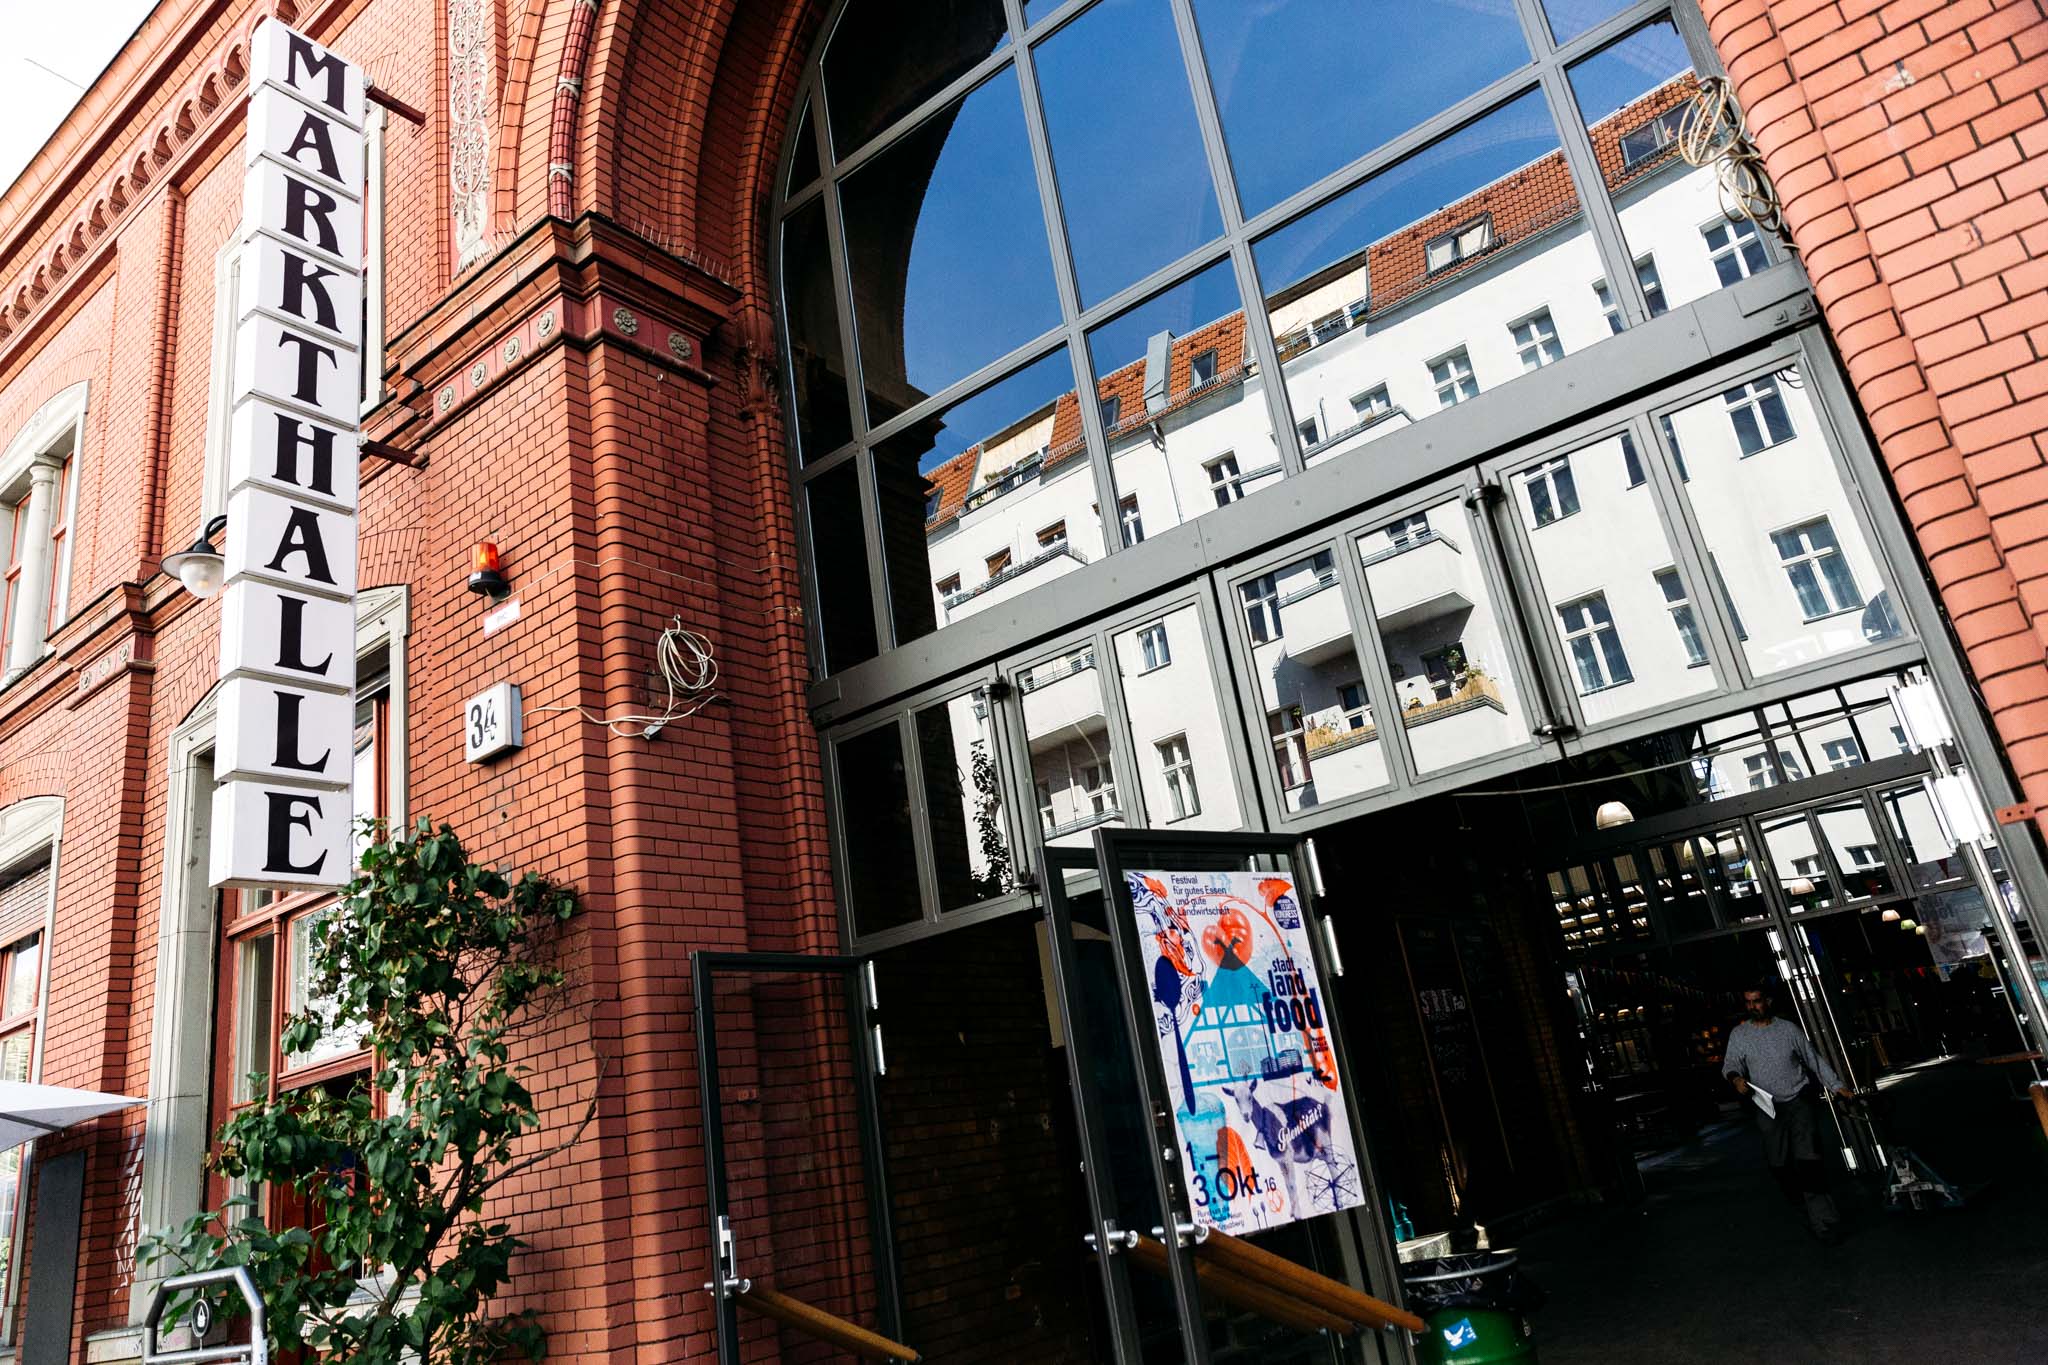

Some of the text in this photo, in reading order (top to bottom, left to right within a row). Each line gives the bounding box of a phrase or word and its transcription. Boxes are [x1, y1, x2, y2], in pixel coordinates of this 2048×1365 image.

[261, 30, 350, 876] MARKTHALLE
[470, 698, 497, 750] 34
[1170, 874, 1198, 885] Festival
[1173, 885, 1227, 898] für gutes Essen
[1176, 897, 1207, 908] und gute
[1177, 905, 1231, 916] Landwirtschaft
[1272, 957, 1296, 972] stadt
[1267, 968, 1308, 997] land
[1262, 987, 1324, 1034] food
[1277, 1103, 1323, 1152] Identität?
[1264, 1177, 1277, 1192] 16
